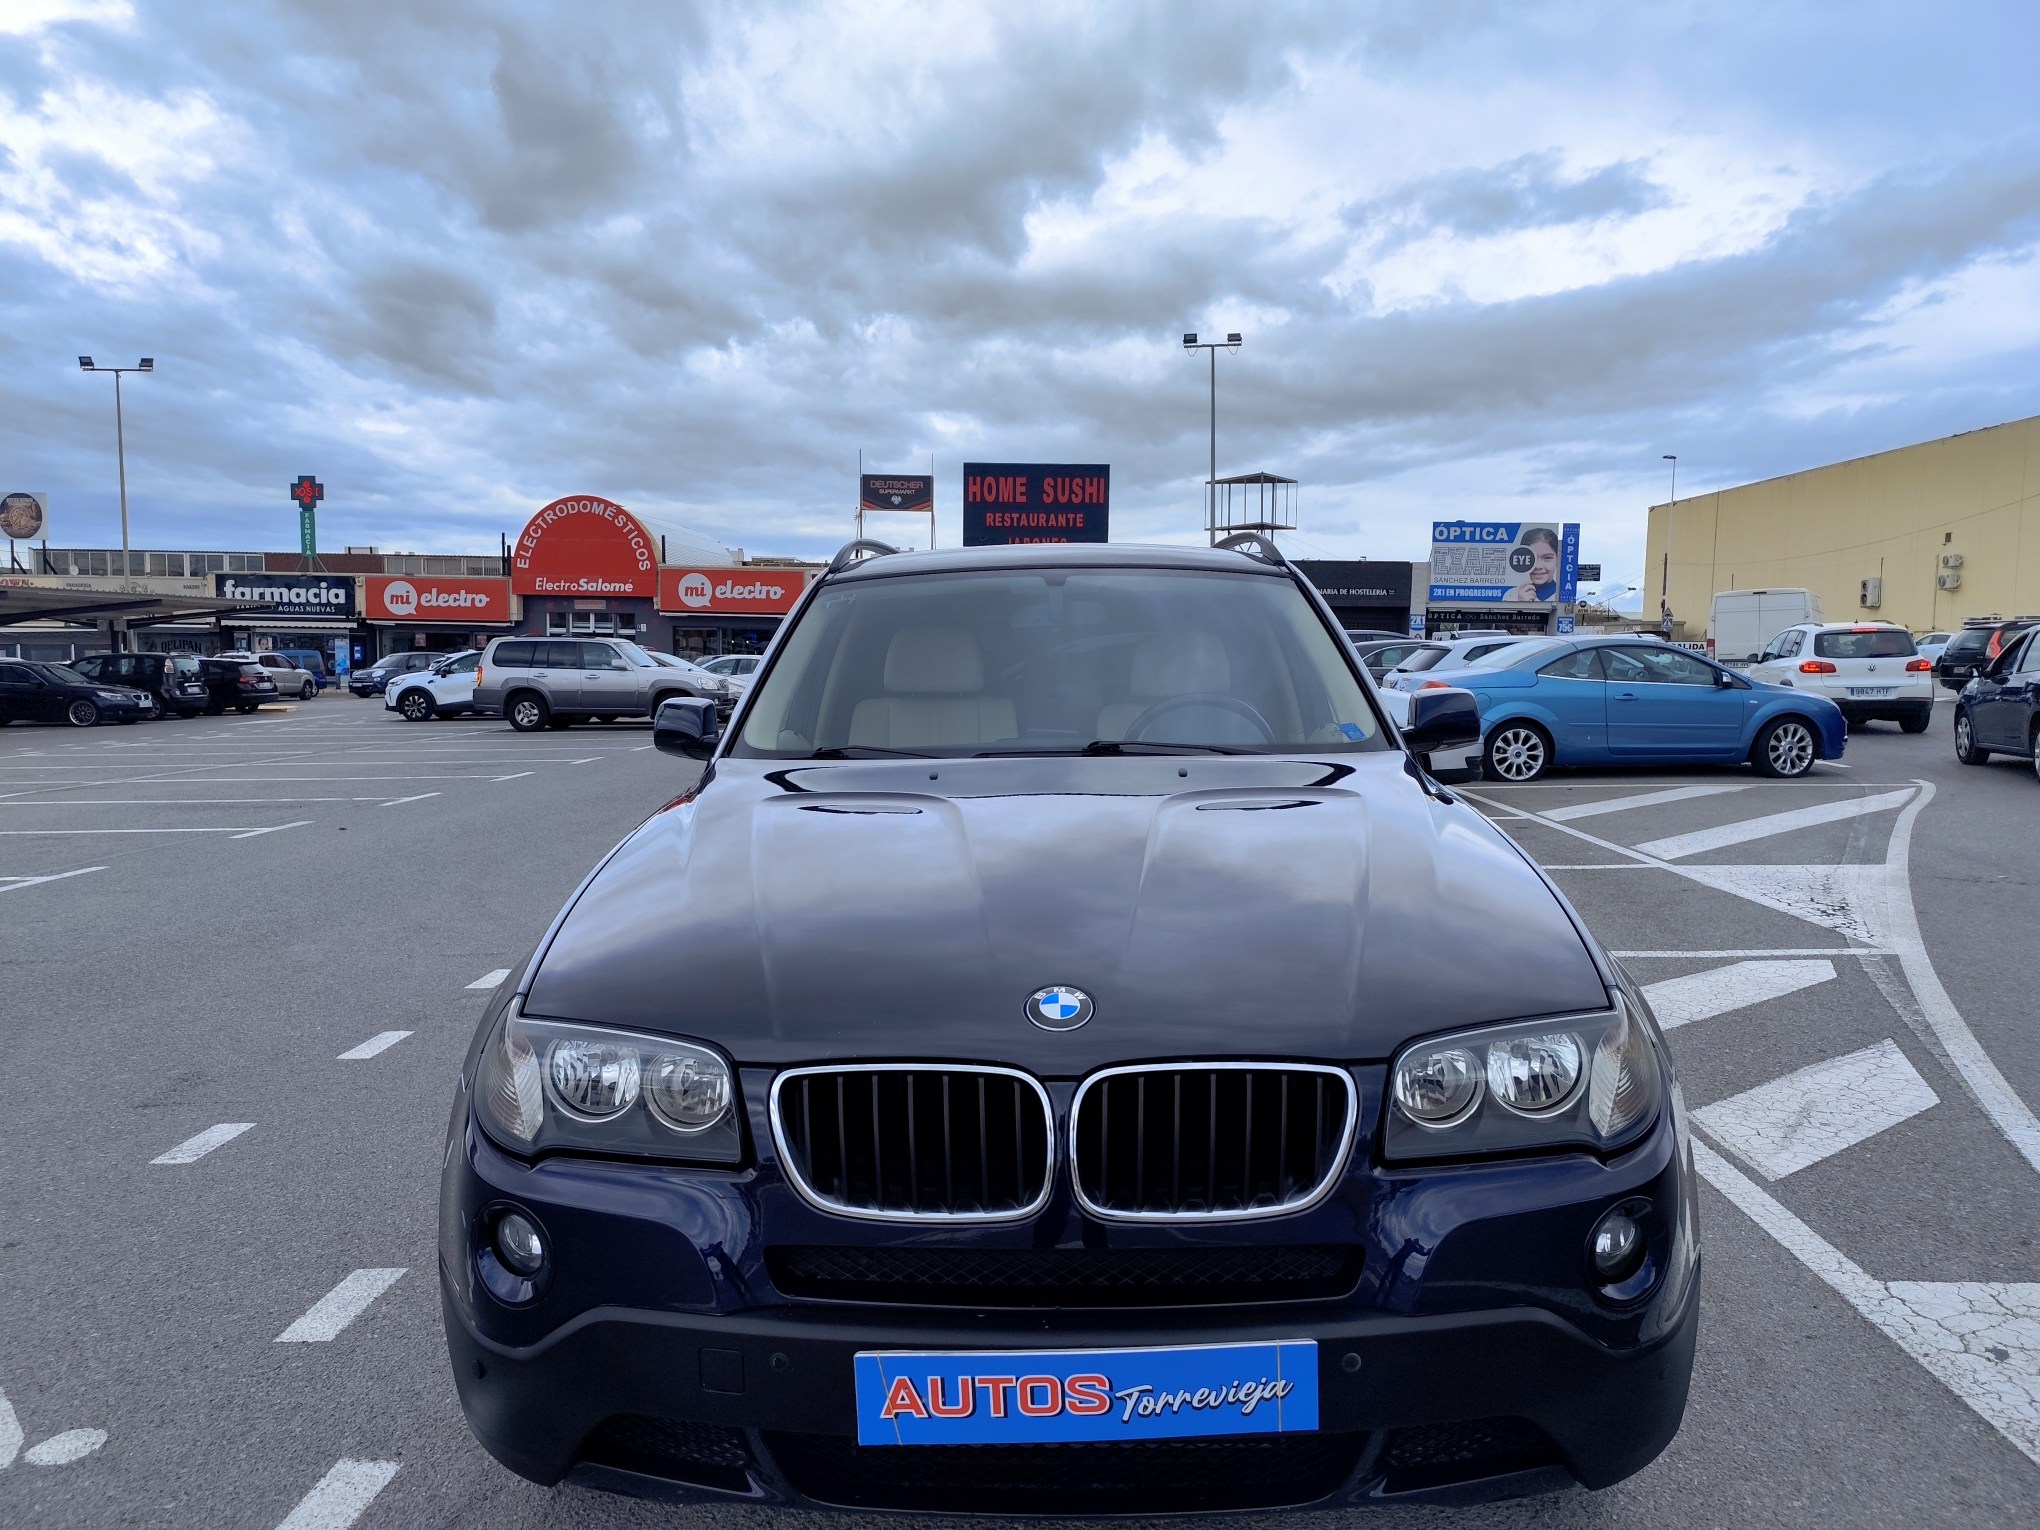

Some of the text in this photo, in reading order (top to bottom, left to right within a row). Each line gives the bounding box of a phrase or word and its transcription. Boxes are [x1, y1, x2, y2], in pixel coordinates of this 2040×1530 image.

[870, 480, 924, 489] DEUTSCHER
[968, 476, 1105, 504] HOME SUSHI
[986, 513, 1084, 528] RESTAURANTE
[304, 512, 312, 556] FARMACIA
[516, 500, 651, 571] ELECTRODOMÉSTICOS
[1434, 524, 1509, 541] ÓPTICA
[1512, 555, 1531, 566] EYE
[223, 579, 347, 604] farmacia
[535, 577, 634, 592] ElectroSalomé
[684, 580, 785, 600] mi electro
[1350, 588, 1388, 596] HOSTELERIA
[389, 588, 491, 608] mi electro
[1446, 588, 1455, 597] EN
[1455, 588, 1502, 597] PROGRESIVOS
[306, 605, 336, 613] NUEVAS
[1427, 611, 1462, 620] ÓPTICA
[1410, 615, 1426, 625] 2X1
[160, 640, 202, 654] DELIPAN
[1034, 987, 1087, 1000] BMW
[879, 1373, 1294, 1424] AUTOS Torrevieja
